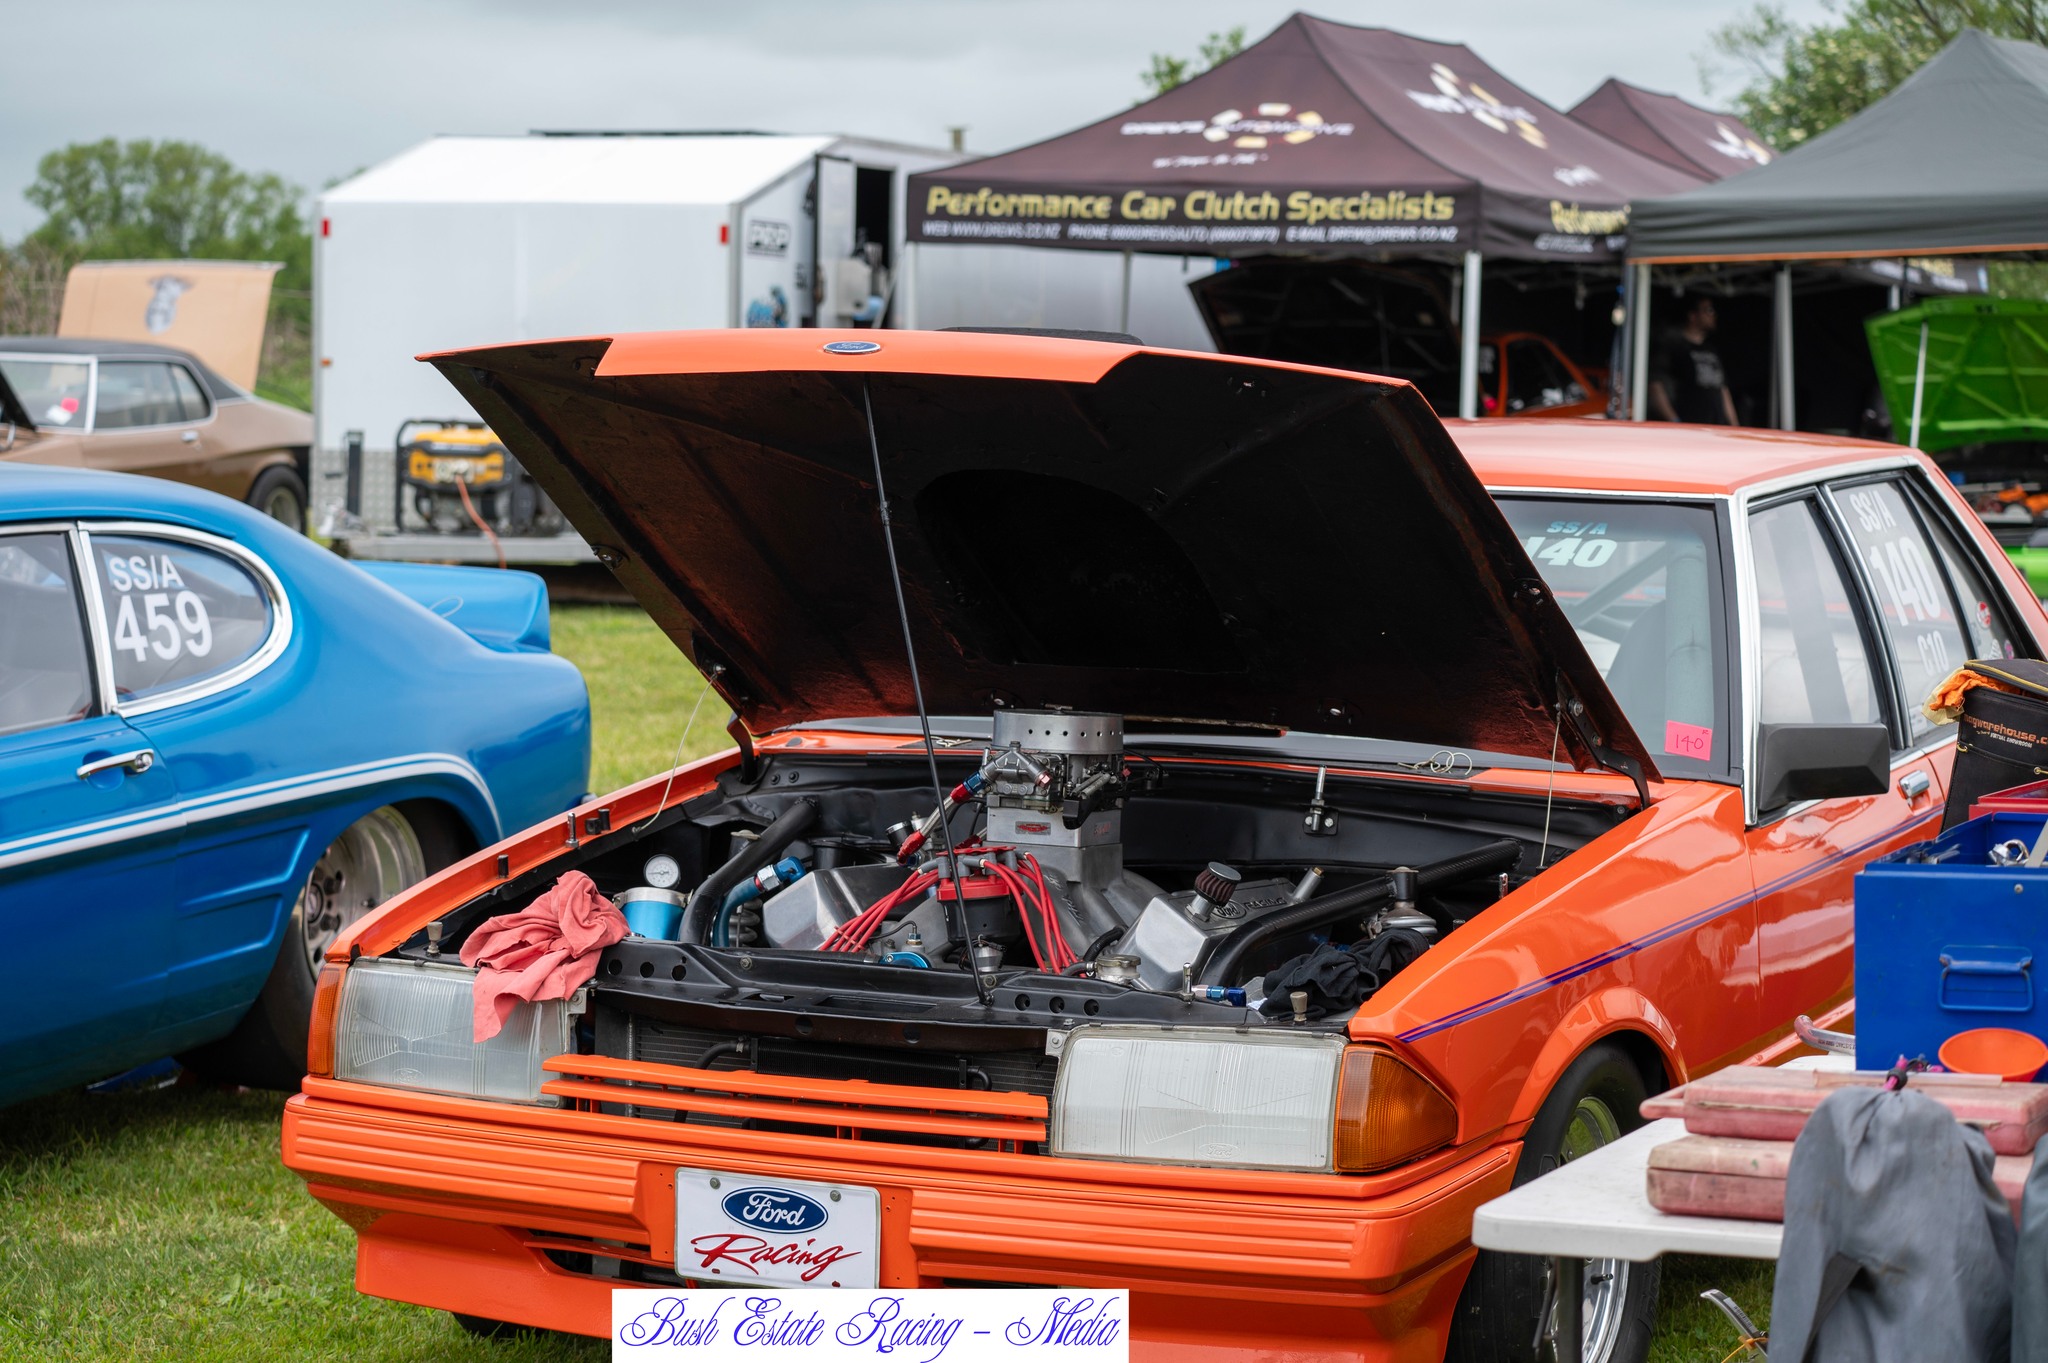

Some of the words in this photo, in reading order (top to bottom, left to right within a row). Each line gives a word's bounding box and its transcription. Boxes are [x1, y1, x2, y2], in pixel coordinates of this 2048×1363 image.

[926, 186, 1112, 219] Performance
[1121, 190, 1176, 220] Car
[1184, 190, 1280, 221] Clutch
[1286, 190, 1454, 225] Specialists
[1546, 521, 1608, 537] SS/A
[1850, 489, 1897, 533] SS/A
[1524, 536, 1618, 568] 140
[109, 555, 186, 592] SS/A
[1868, 536, 1942, 627] 140
[114, 590, 213, 662] 459
[1675, 734, 1704, 752] 140
[742, 1192, 806, 1226] Ford
[690, 1233, 862, 1282] Racing
